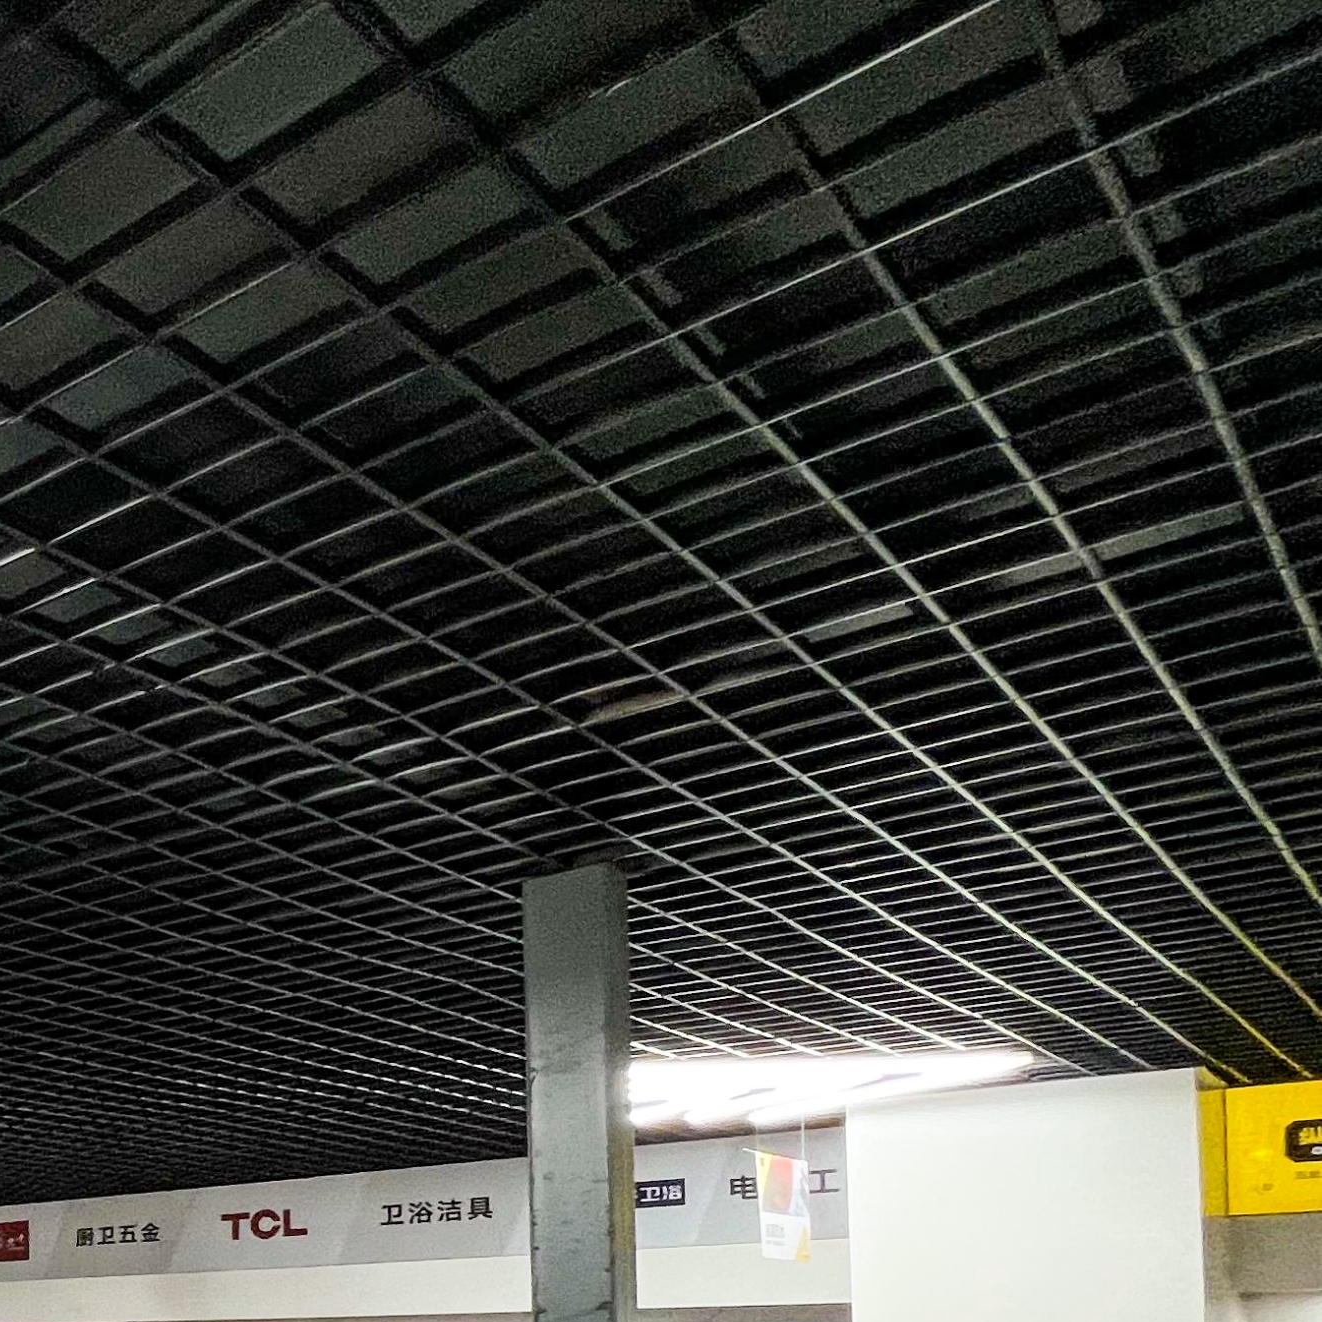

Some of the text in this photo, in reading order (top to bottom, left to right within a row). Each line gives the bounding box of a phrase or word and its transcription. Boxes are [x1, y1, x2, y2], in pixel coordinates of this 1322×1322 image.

[221, 1209, 308, 1241] TCL
[380, 1196, 494, 1227] 卫浴洁具
[76, 1223, 160, 1247] 厨卫五金
